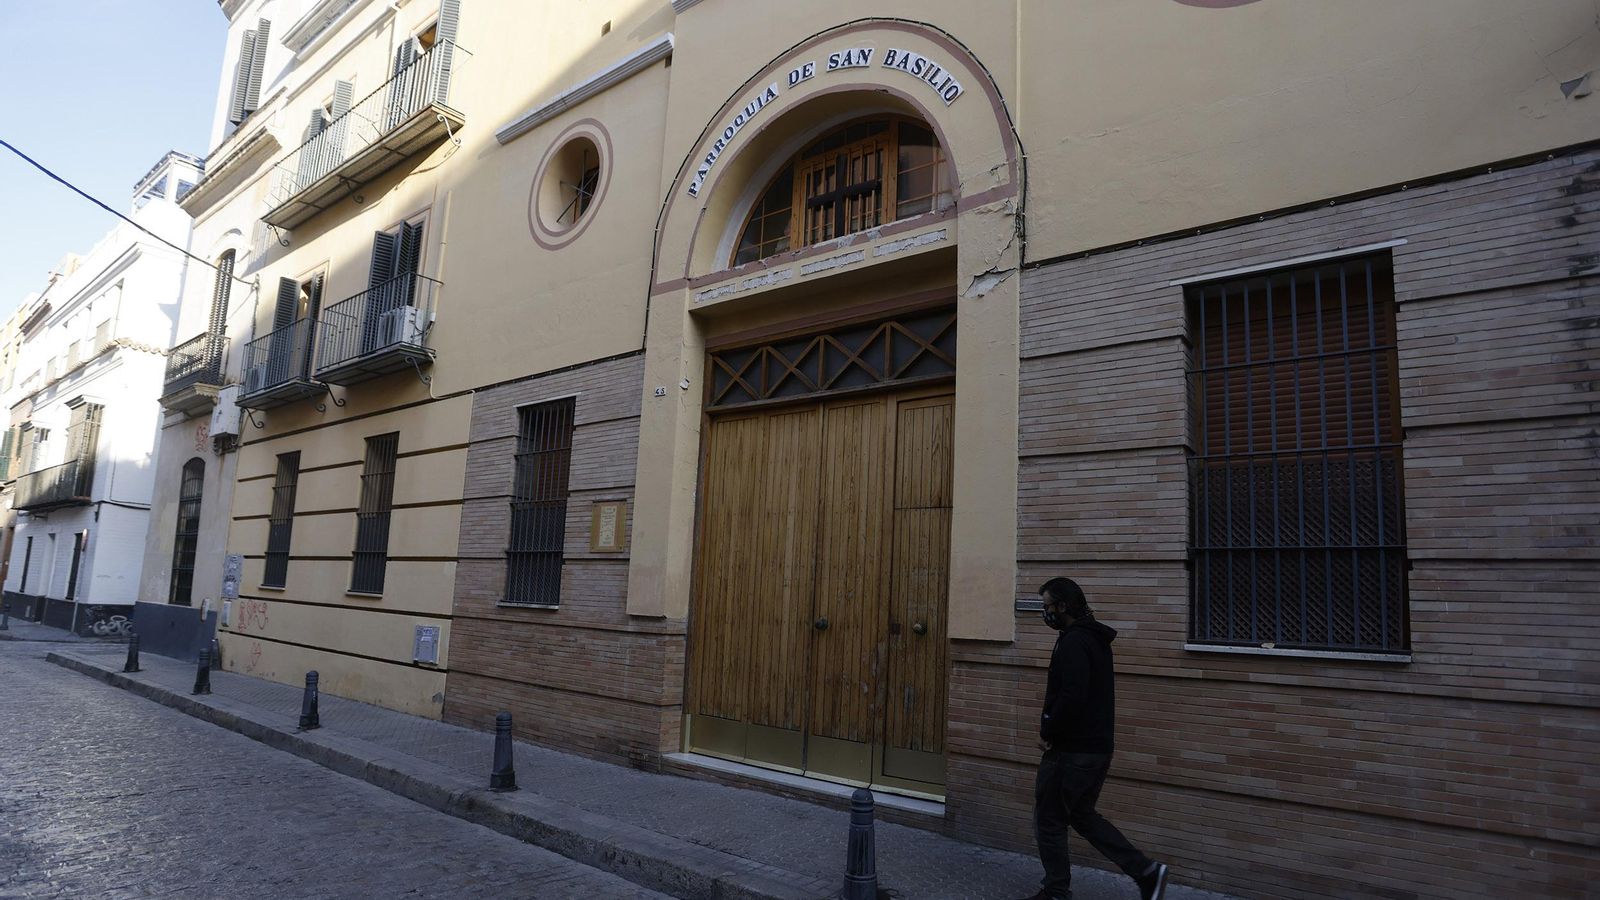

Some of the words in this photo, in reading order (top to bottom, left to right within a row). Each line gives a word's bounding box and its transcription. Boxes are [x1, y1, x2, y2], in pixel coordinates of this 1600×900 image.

[688, 87, 776, 195] PARROQUIA
[788, 62, 814, 87] DE
[828, 49, 873, 70] SAN
[883, 49, 959, 102] BASILIO
